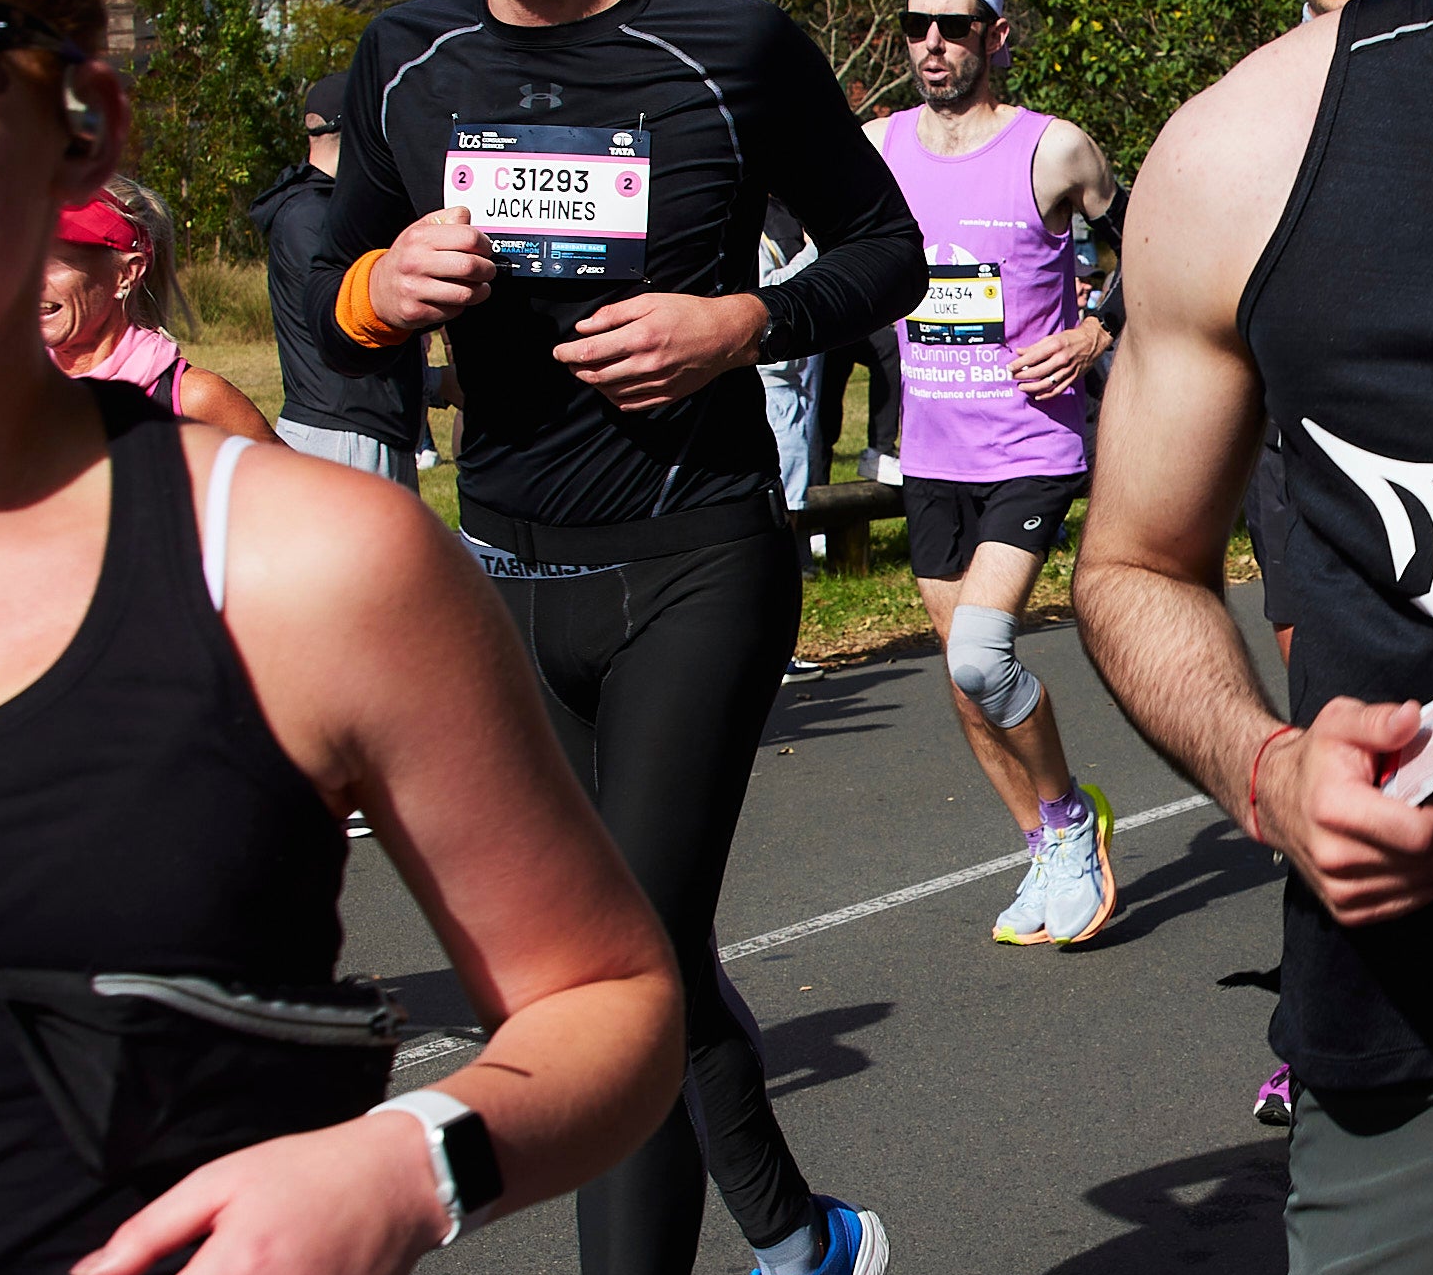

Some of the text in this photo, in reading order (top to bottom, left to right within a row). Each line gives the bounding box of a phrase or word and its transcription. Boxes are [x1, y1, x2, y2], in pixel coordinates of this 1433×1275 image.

[457, 131, 481, 149] tcs
[609, 147, 635, 156] TATA
[458, 171, 467, 184] 2
[495, 167, 589, 193] C31293
[623, 177, 633, 190] 2
[486, 198, 596, 221] JACK HINES
[933, 303, 959, 315] LUKE
[911, 345, 1000, 365] Running for
[932, 389, 963, 399] chance
[965, 389, 975, 399] of
[976, 388, 1013, 398] survival
